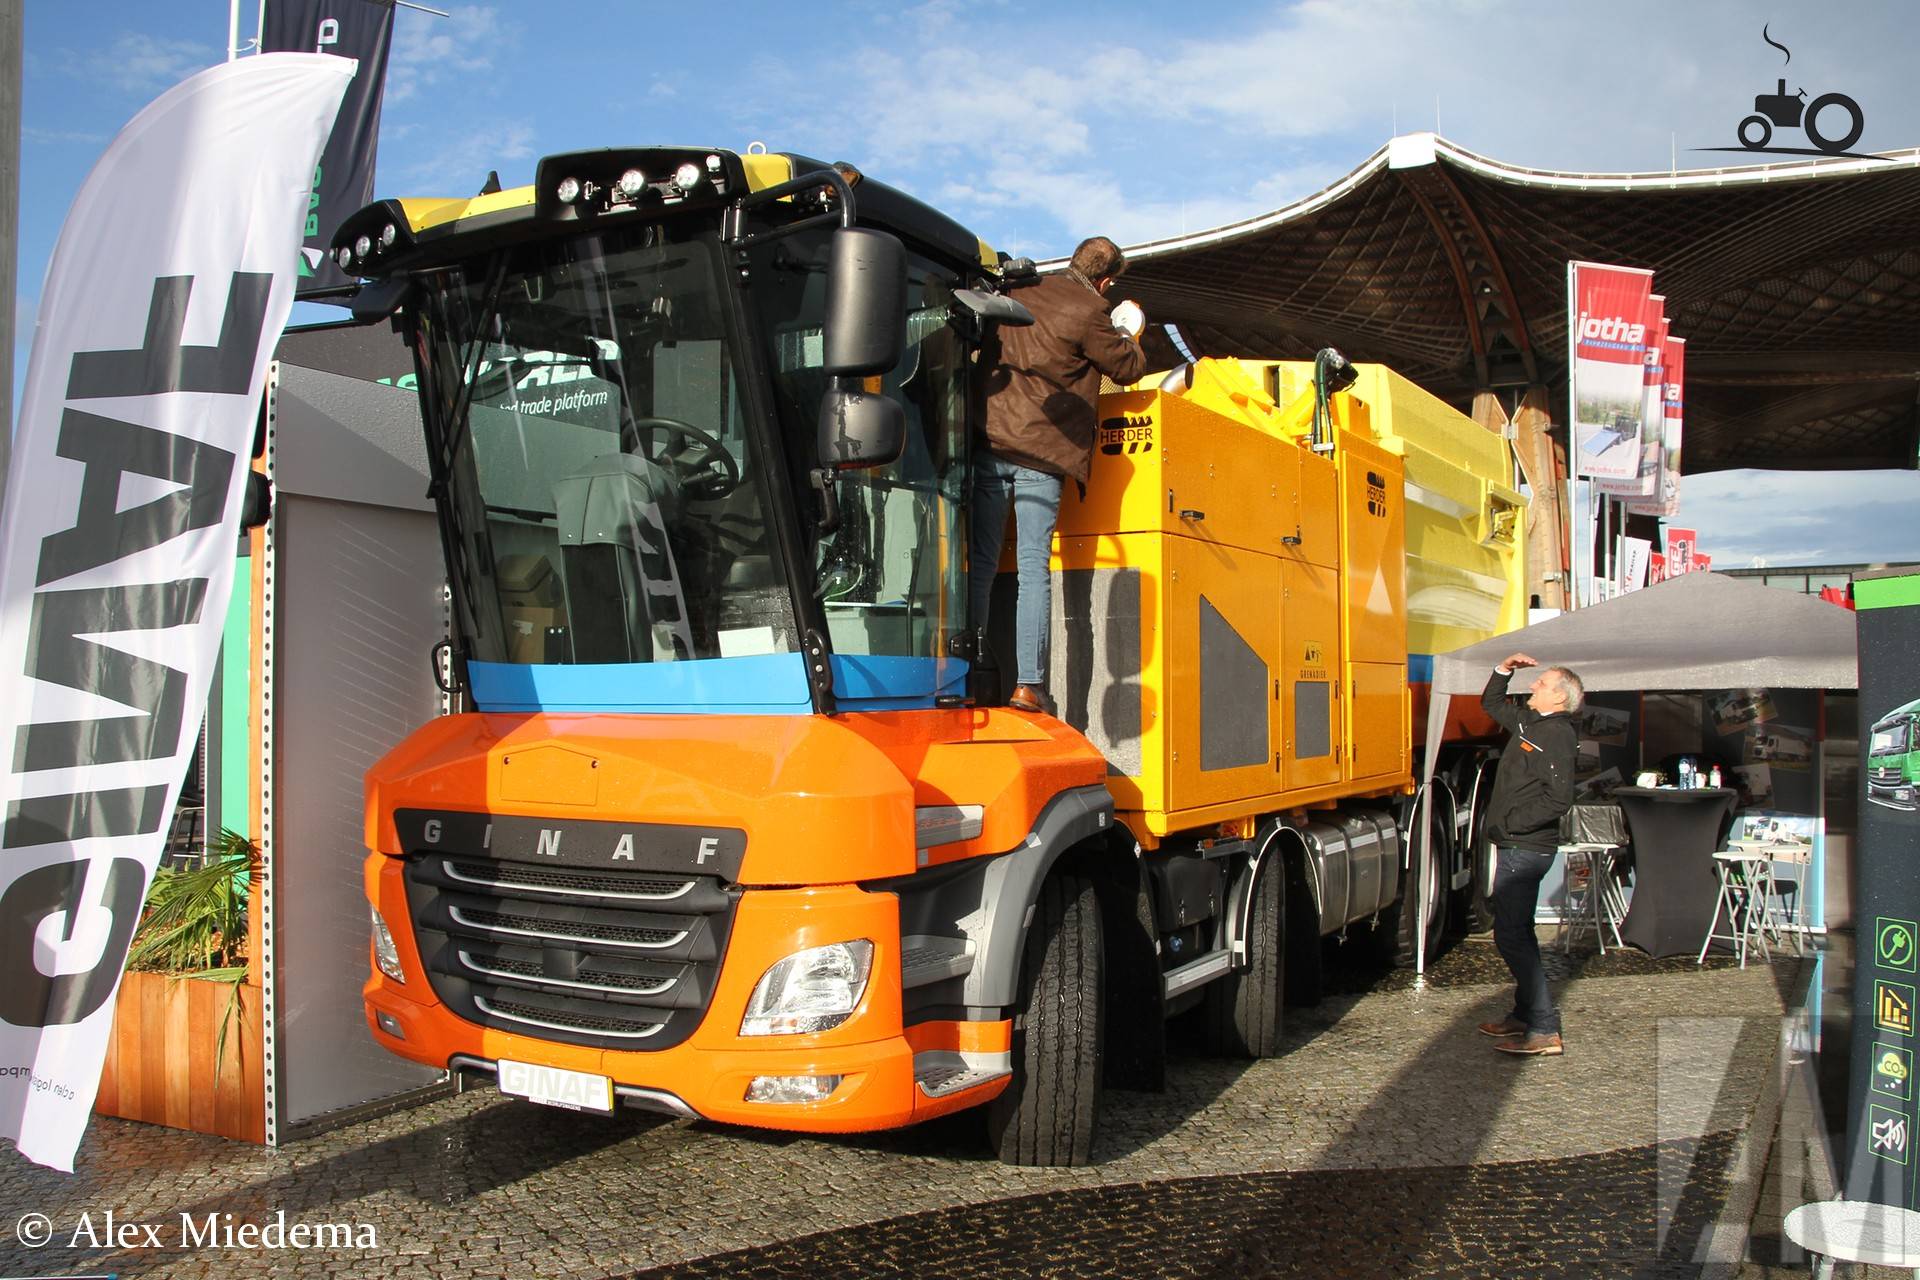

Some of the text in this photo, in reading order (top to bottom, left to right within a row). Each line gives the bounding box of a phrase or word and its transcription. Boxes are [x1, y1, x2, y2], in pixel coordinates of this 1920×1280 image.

[1577, 311, 1645, 344] jotha
[520, 396, 552, 415] trade
[1100, 428, 1153, 443] HERDER
[1366, 485, 1386, 504] HERDER
[504, 1063, 602, 1104] GINAF
